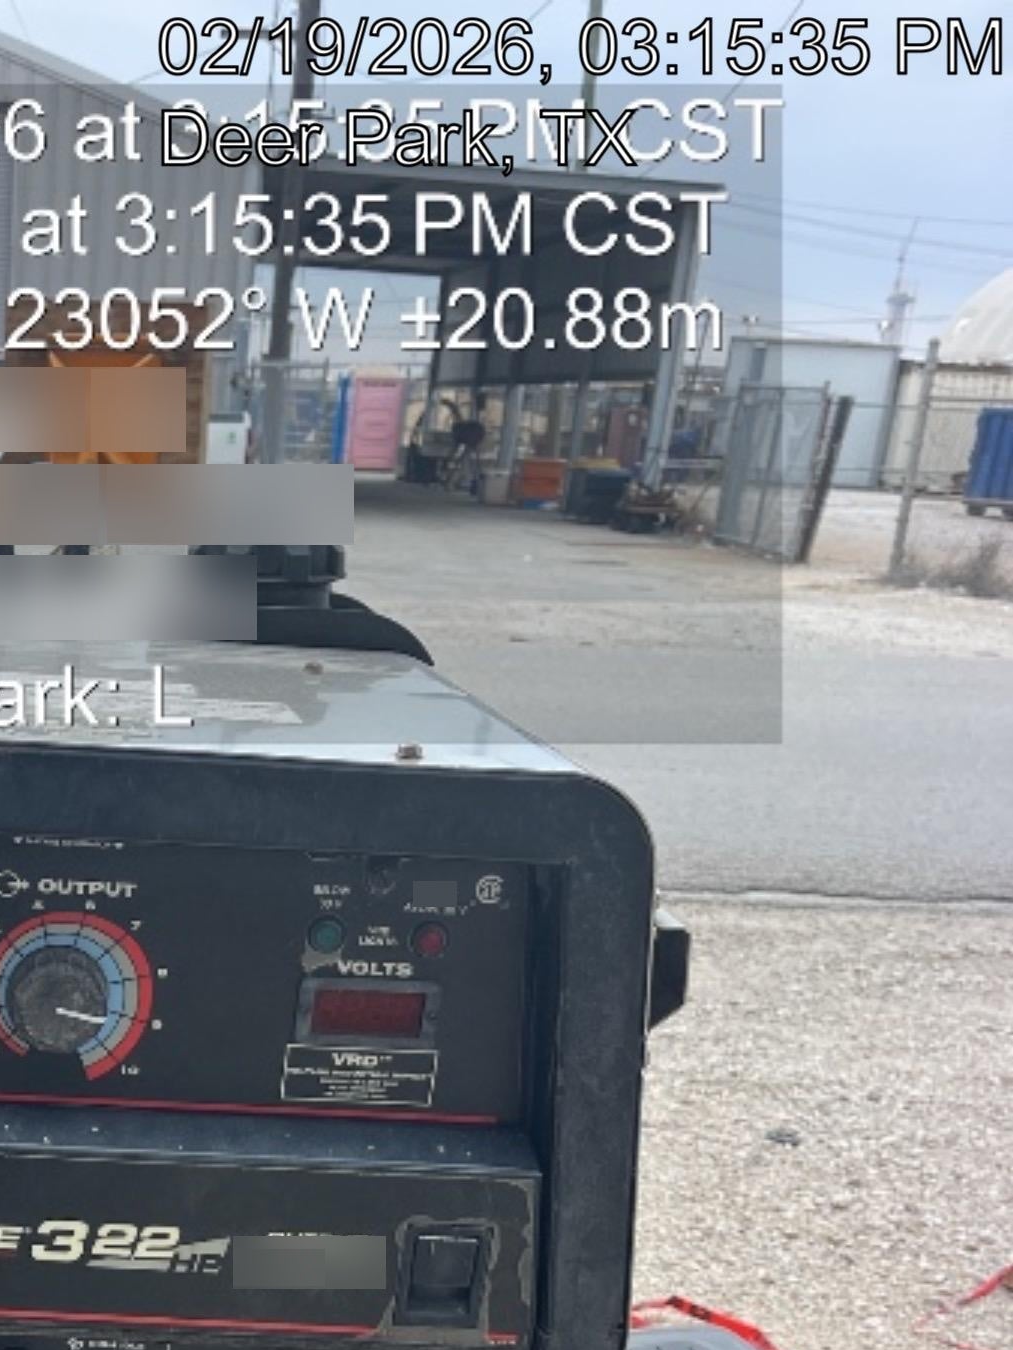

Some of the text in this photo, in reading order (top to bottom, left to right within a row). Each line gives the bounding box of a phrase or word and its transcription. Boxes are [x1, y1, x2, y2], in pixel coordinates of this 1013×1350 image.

[38, 878, 137, 898] OUTPUT
[338, 961, 414, 979] VOLTS
[31, 1219, 181, 1263] 322
